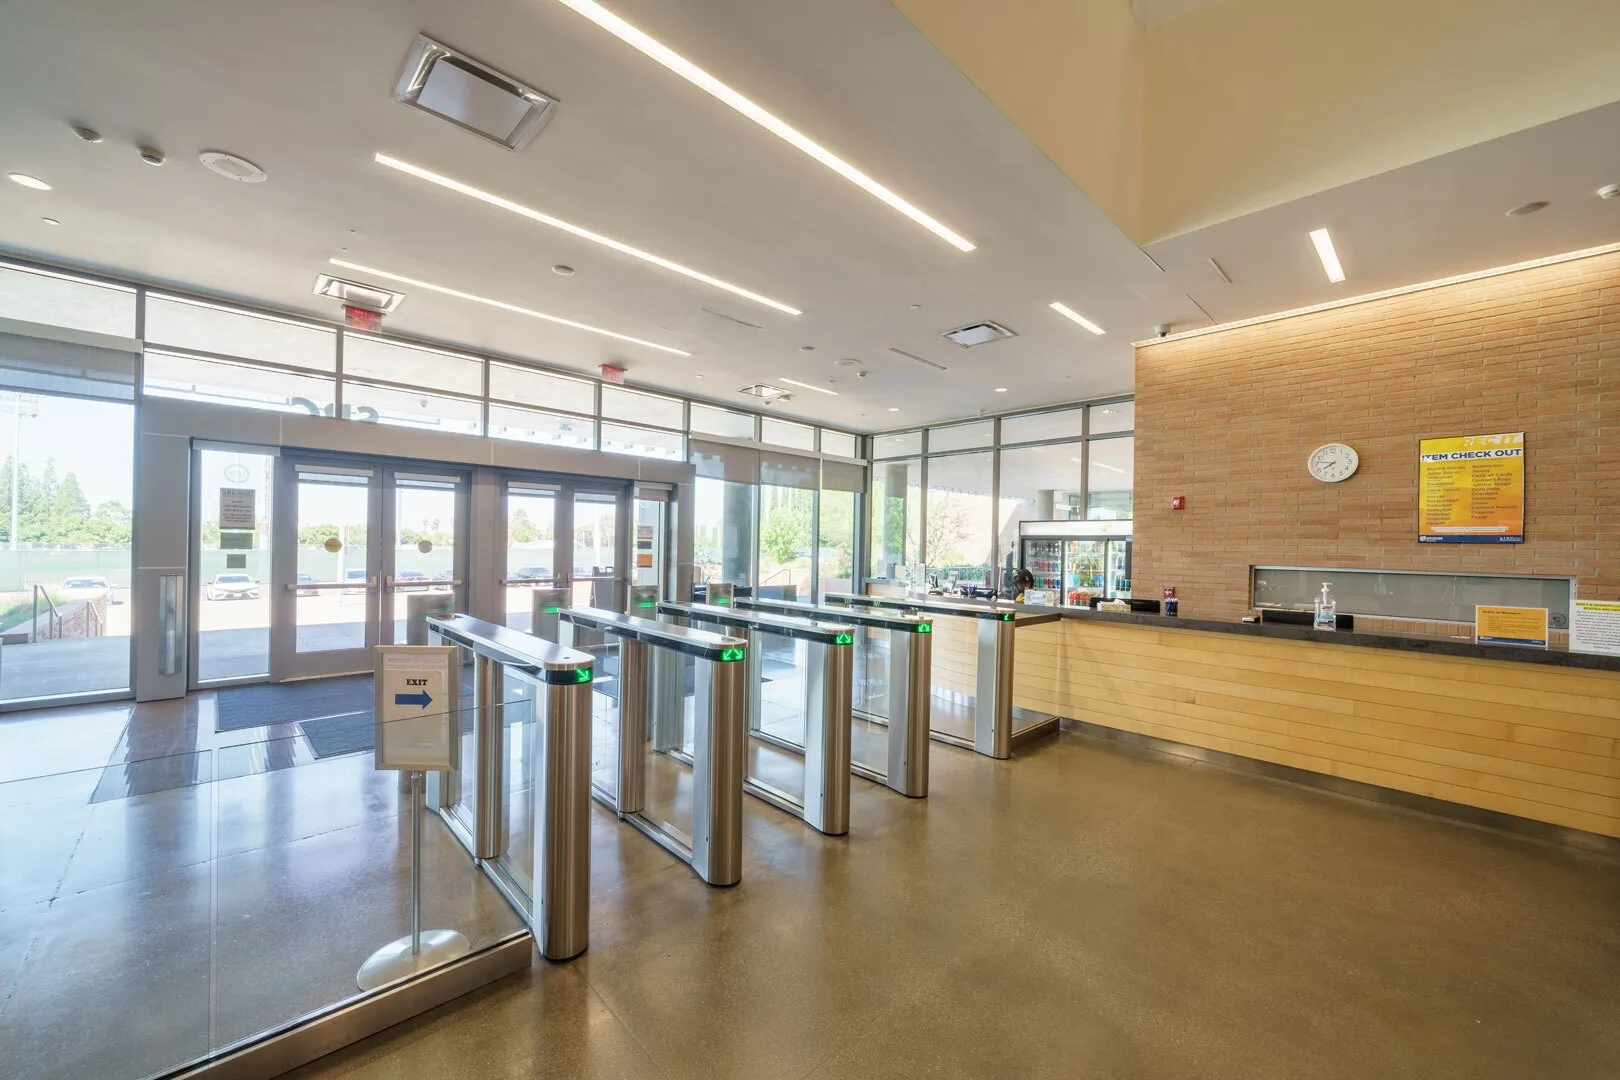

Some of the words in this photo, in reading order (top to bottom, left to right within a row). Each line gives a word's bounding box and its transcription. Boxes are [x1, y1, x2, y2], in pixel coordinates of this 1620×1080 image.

[1422, 454, 1448, 462] ITEM
[1451, 450, 1492, 460] CHECK
[1495, 448, 1522, 456] OUT
